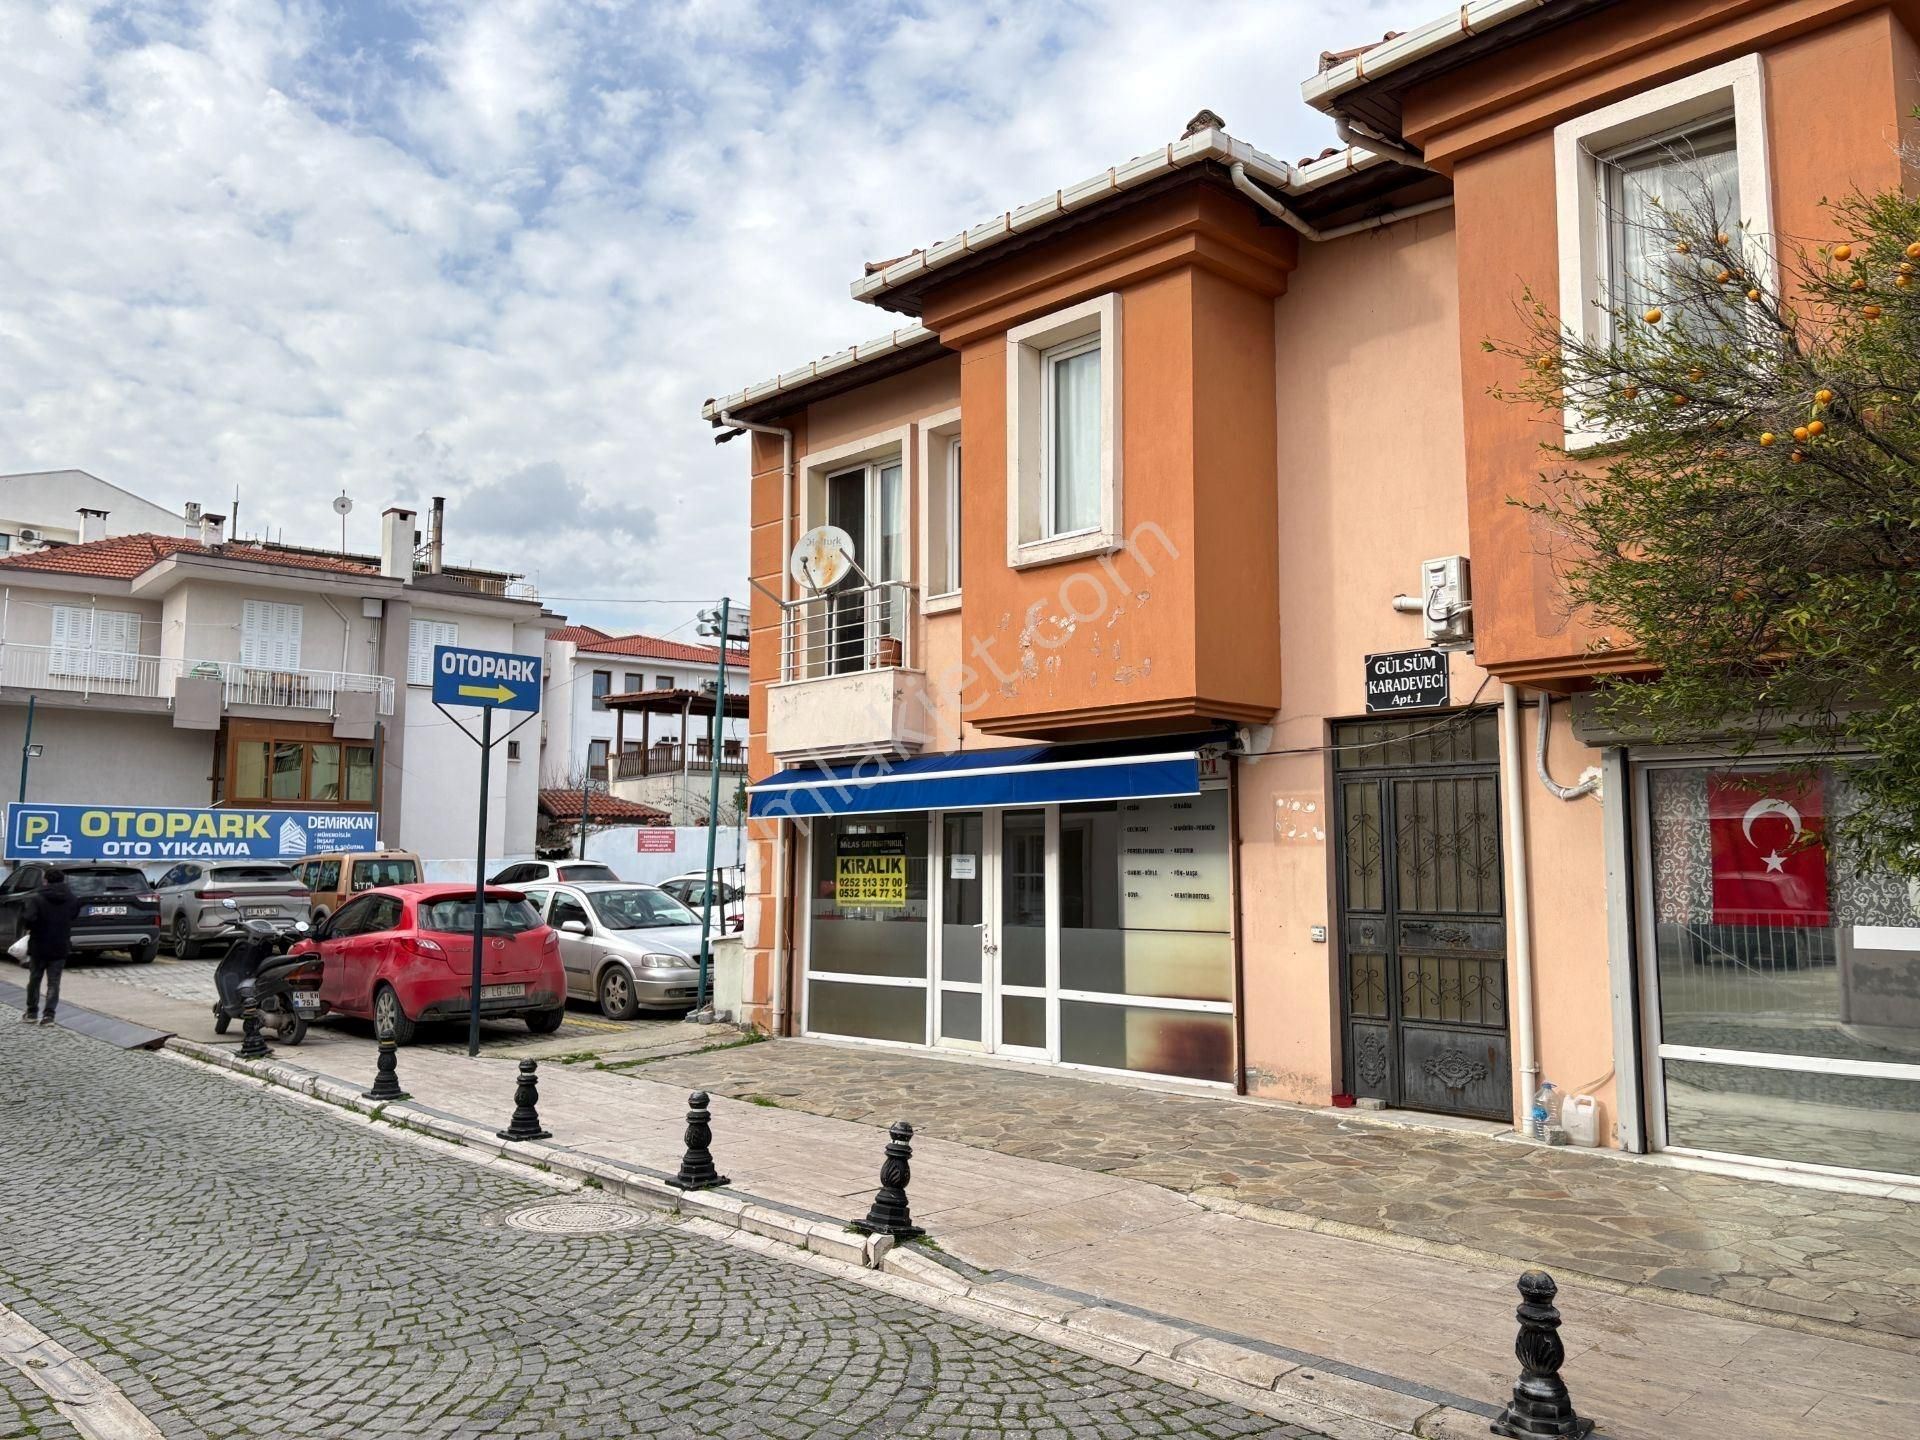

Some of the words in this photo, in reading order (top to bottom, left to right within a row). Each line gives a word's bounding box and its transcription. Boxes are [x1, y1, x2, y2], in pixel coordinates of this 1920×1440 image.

[441, 651, 536, 683] OTOPARK
[1374, 653, 1436, 675] GÜLSÜM
[1369, 670, 1444, 694] KARADEVECİ
[1391, 694, 1414, 706] Apt.
[1415, 692, 1422, 703] 1
[80, 810, 272, 839] OTOPARK
[102, 841, 151, 855] OTO
[160, 841, 250, 856] YIKAMA
[839, 877, 860, 887] 0252
[862, 877, 877, 887] 513
[879, 877, 890, 887] 37
[892, 877, 903, 887] 00
[839, 888, 860, 898] 0532
[879, 888, 890, 898] 77
[892, 888, 903, 898] 34
[491, 986, 502, 997] LG
[506, 985, 520, 996] 400
